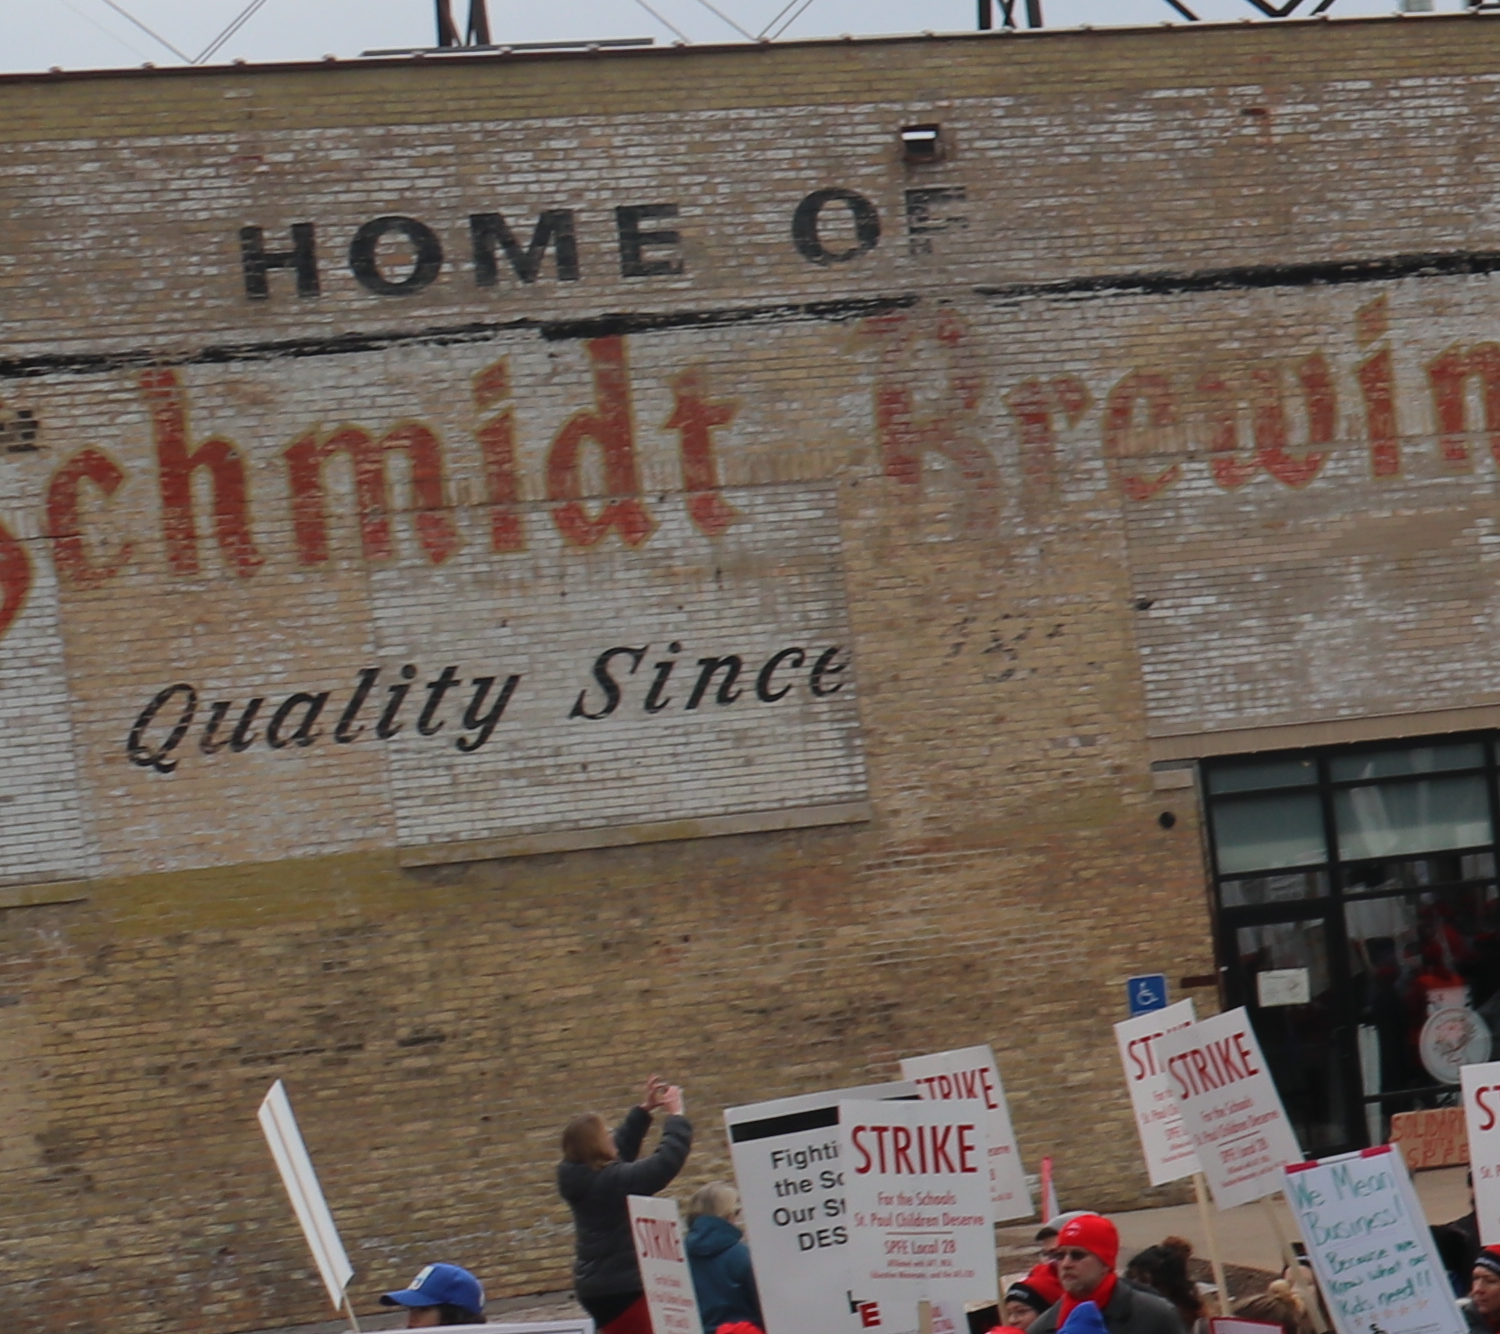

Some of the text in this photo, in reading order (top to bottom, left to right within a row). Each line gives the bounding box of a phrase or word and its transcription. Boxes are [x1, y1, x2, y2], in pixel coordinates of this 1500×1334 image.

[241, 203, 683, 299] HOME
[127, 643, 855, 773] Quality Since
[1168, 1032, 1259, 1100] STRIKE
[852, 1125, 977, 1174] STRIKE
[1332, 1166, 1394, 1199] Mean
